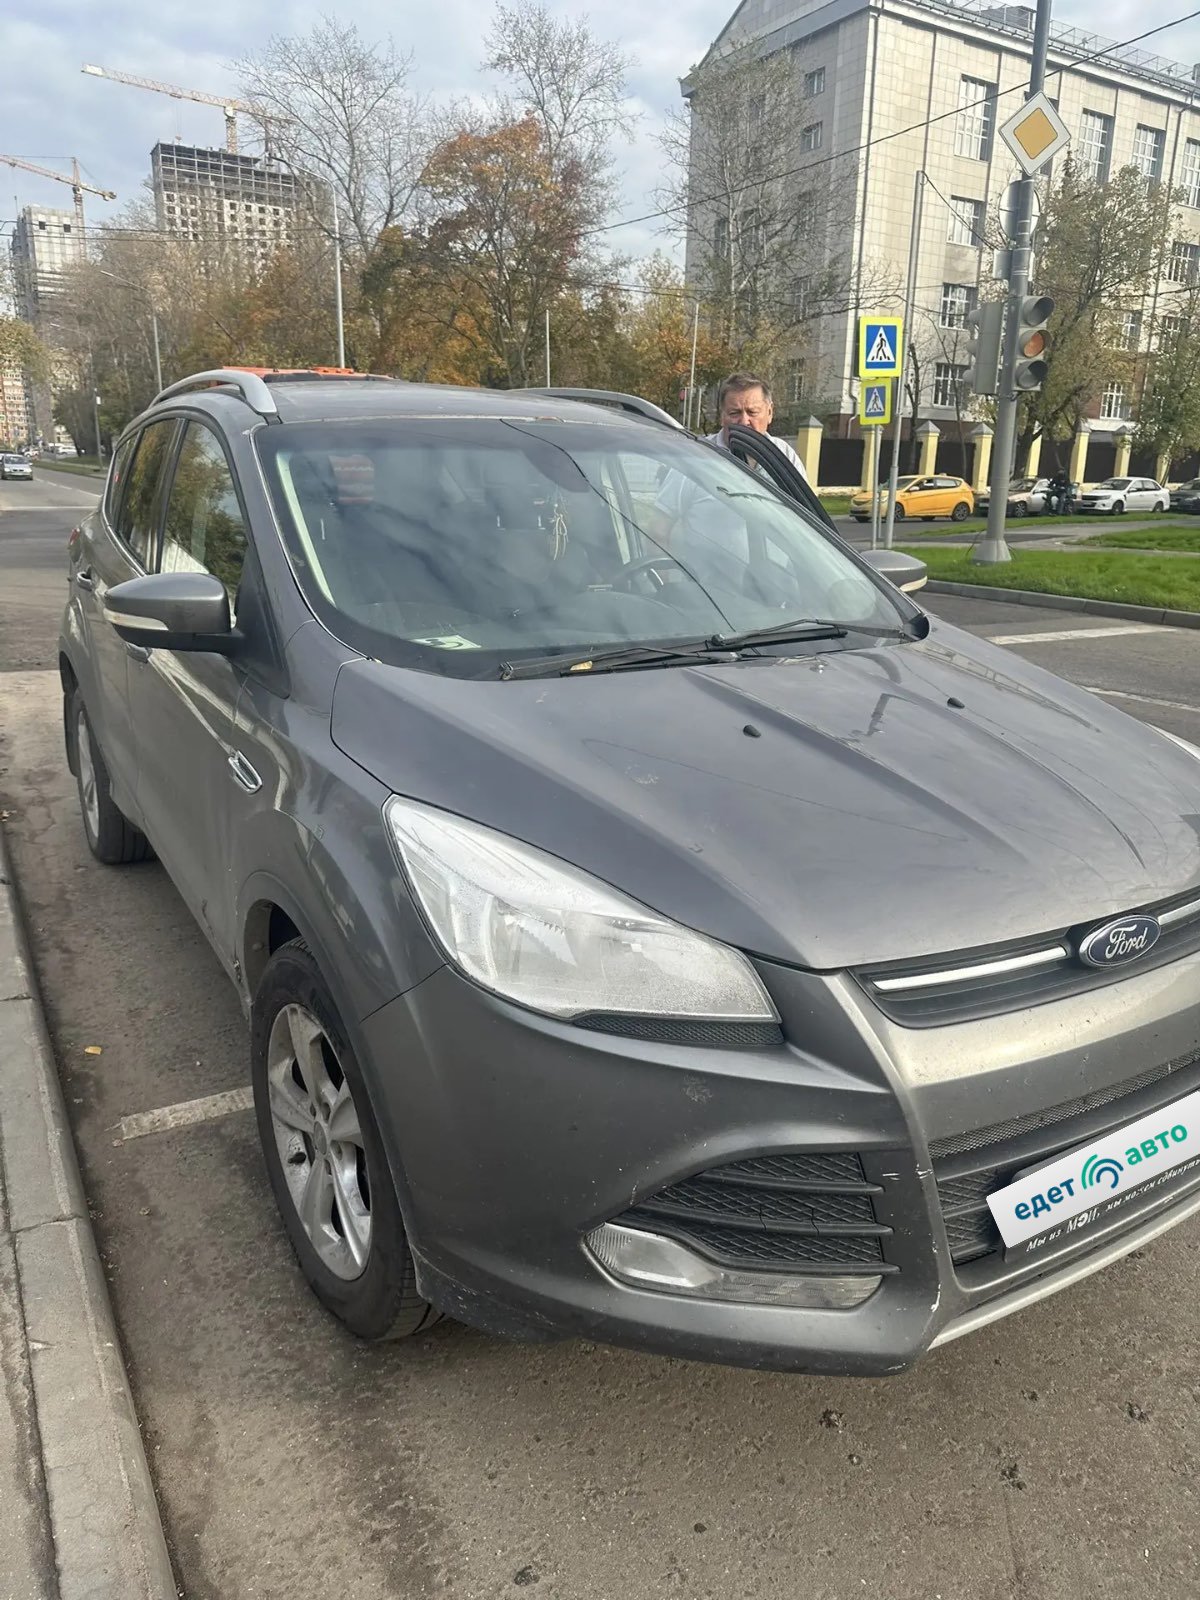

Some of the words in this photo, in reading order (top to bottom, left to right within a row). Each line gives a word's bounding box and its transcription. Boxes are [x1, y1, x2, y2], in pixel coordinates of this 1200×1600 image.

[1105, 924, 1148, 959] Ford
[1026, 1236, 1047, 1252] Мы
[1049, 1229, 1061, 1241] из
